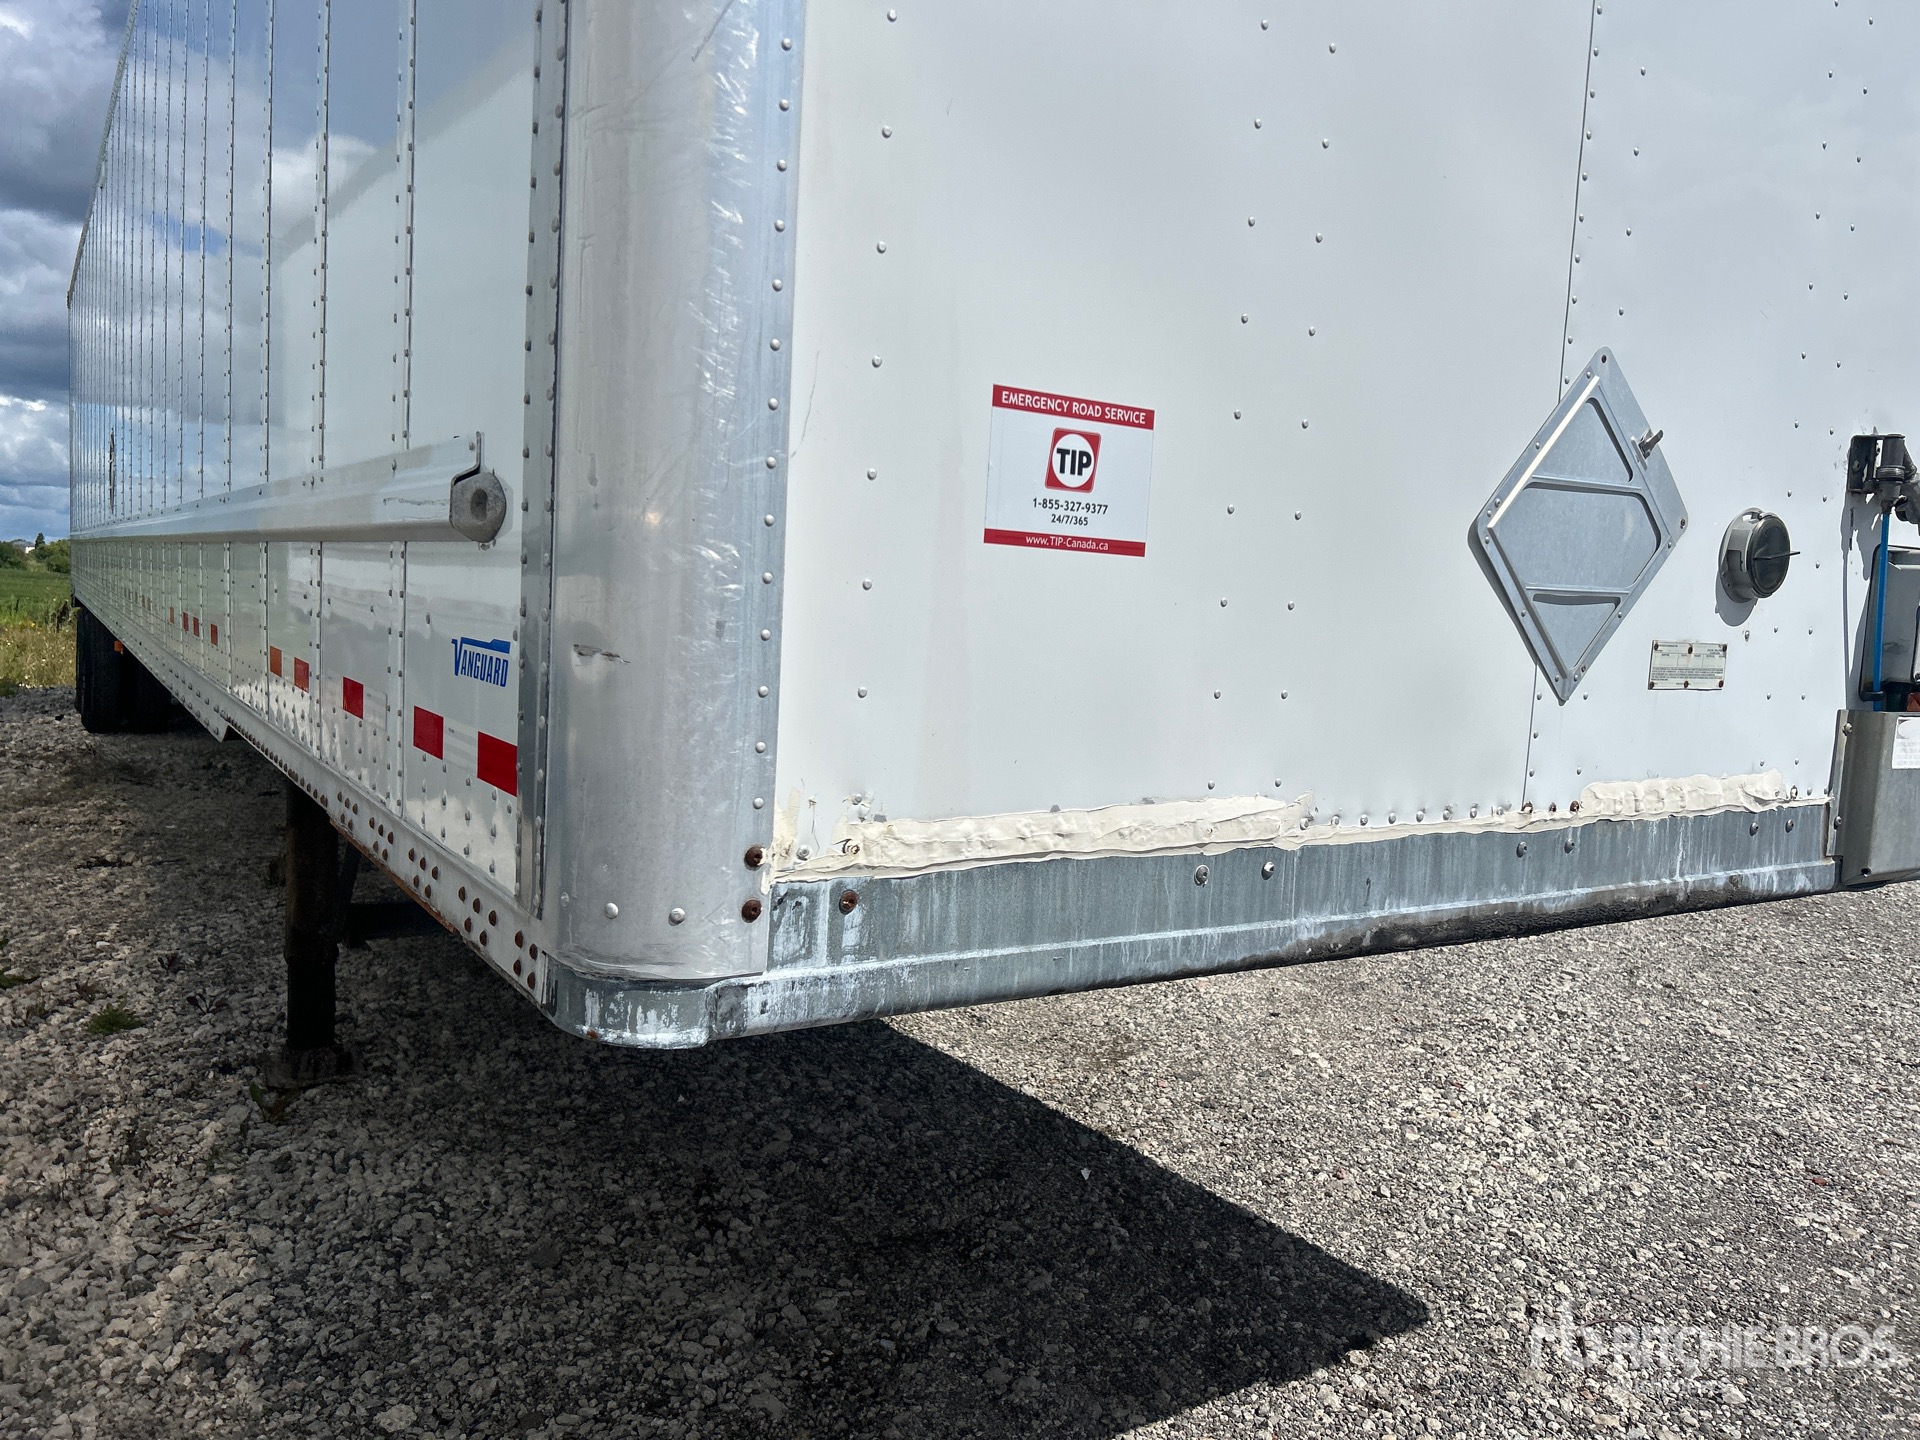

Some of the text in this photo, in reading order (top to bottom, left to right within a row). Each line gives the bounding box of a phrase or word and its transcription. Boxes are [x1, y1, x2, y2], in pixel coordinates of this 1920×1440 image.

[1002, 391, 1146, 422] EMERGENCY ROAD SERVICE
[1056, 447, 1092, 476] TIP
[1032, 497, 1109, 515] 1-855-327-9377
[1051, 514, 1089, 526] 24/7/365
[1026, 535, 1109, 551] www.TIP-Canada.ca
[451, 637, 510, 687] VANGUARD
